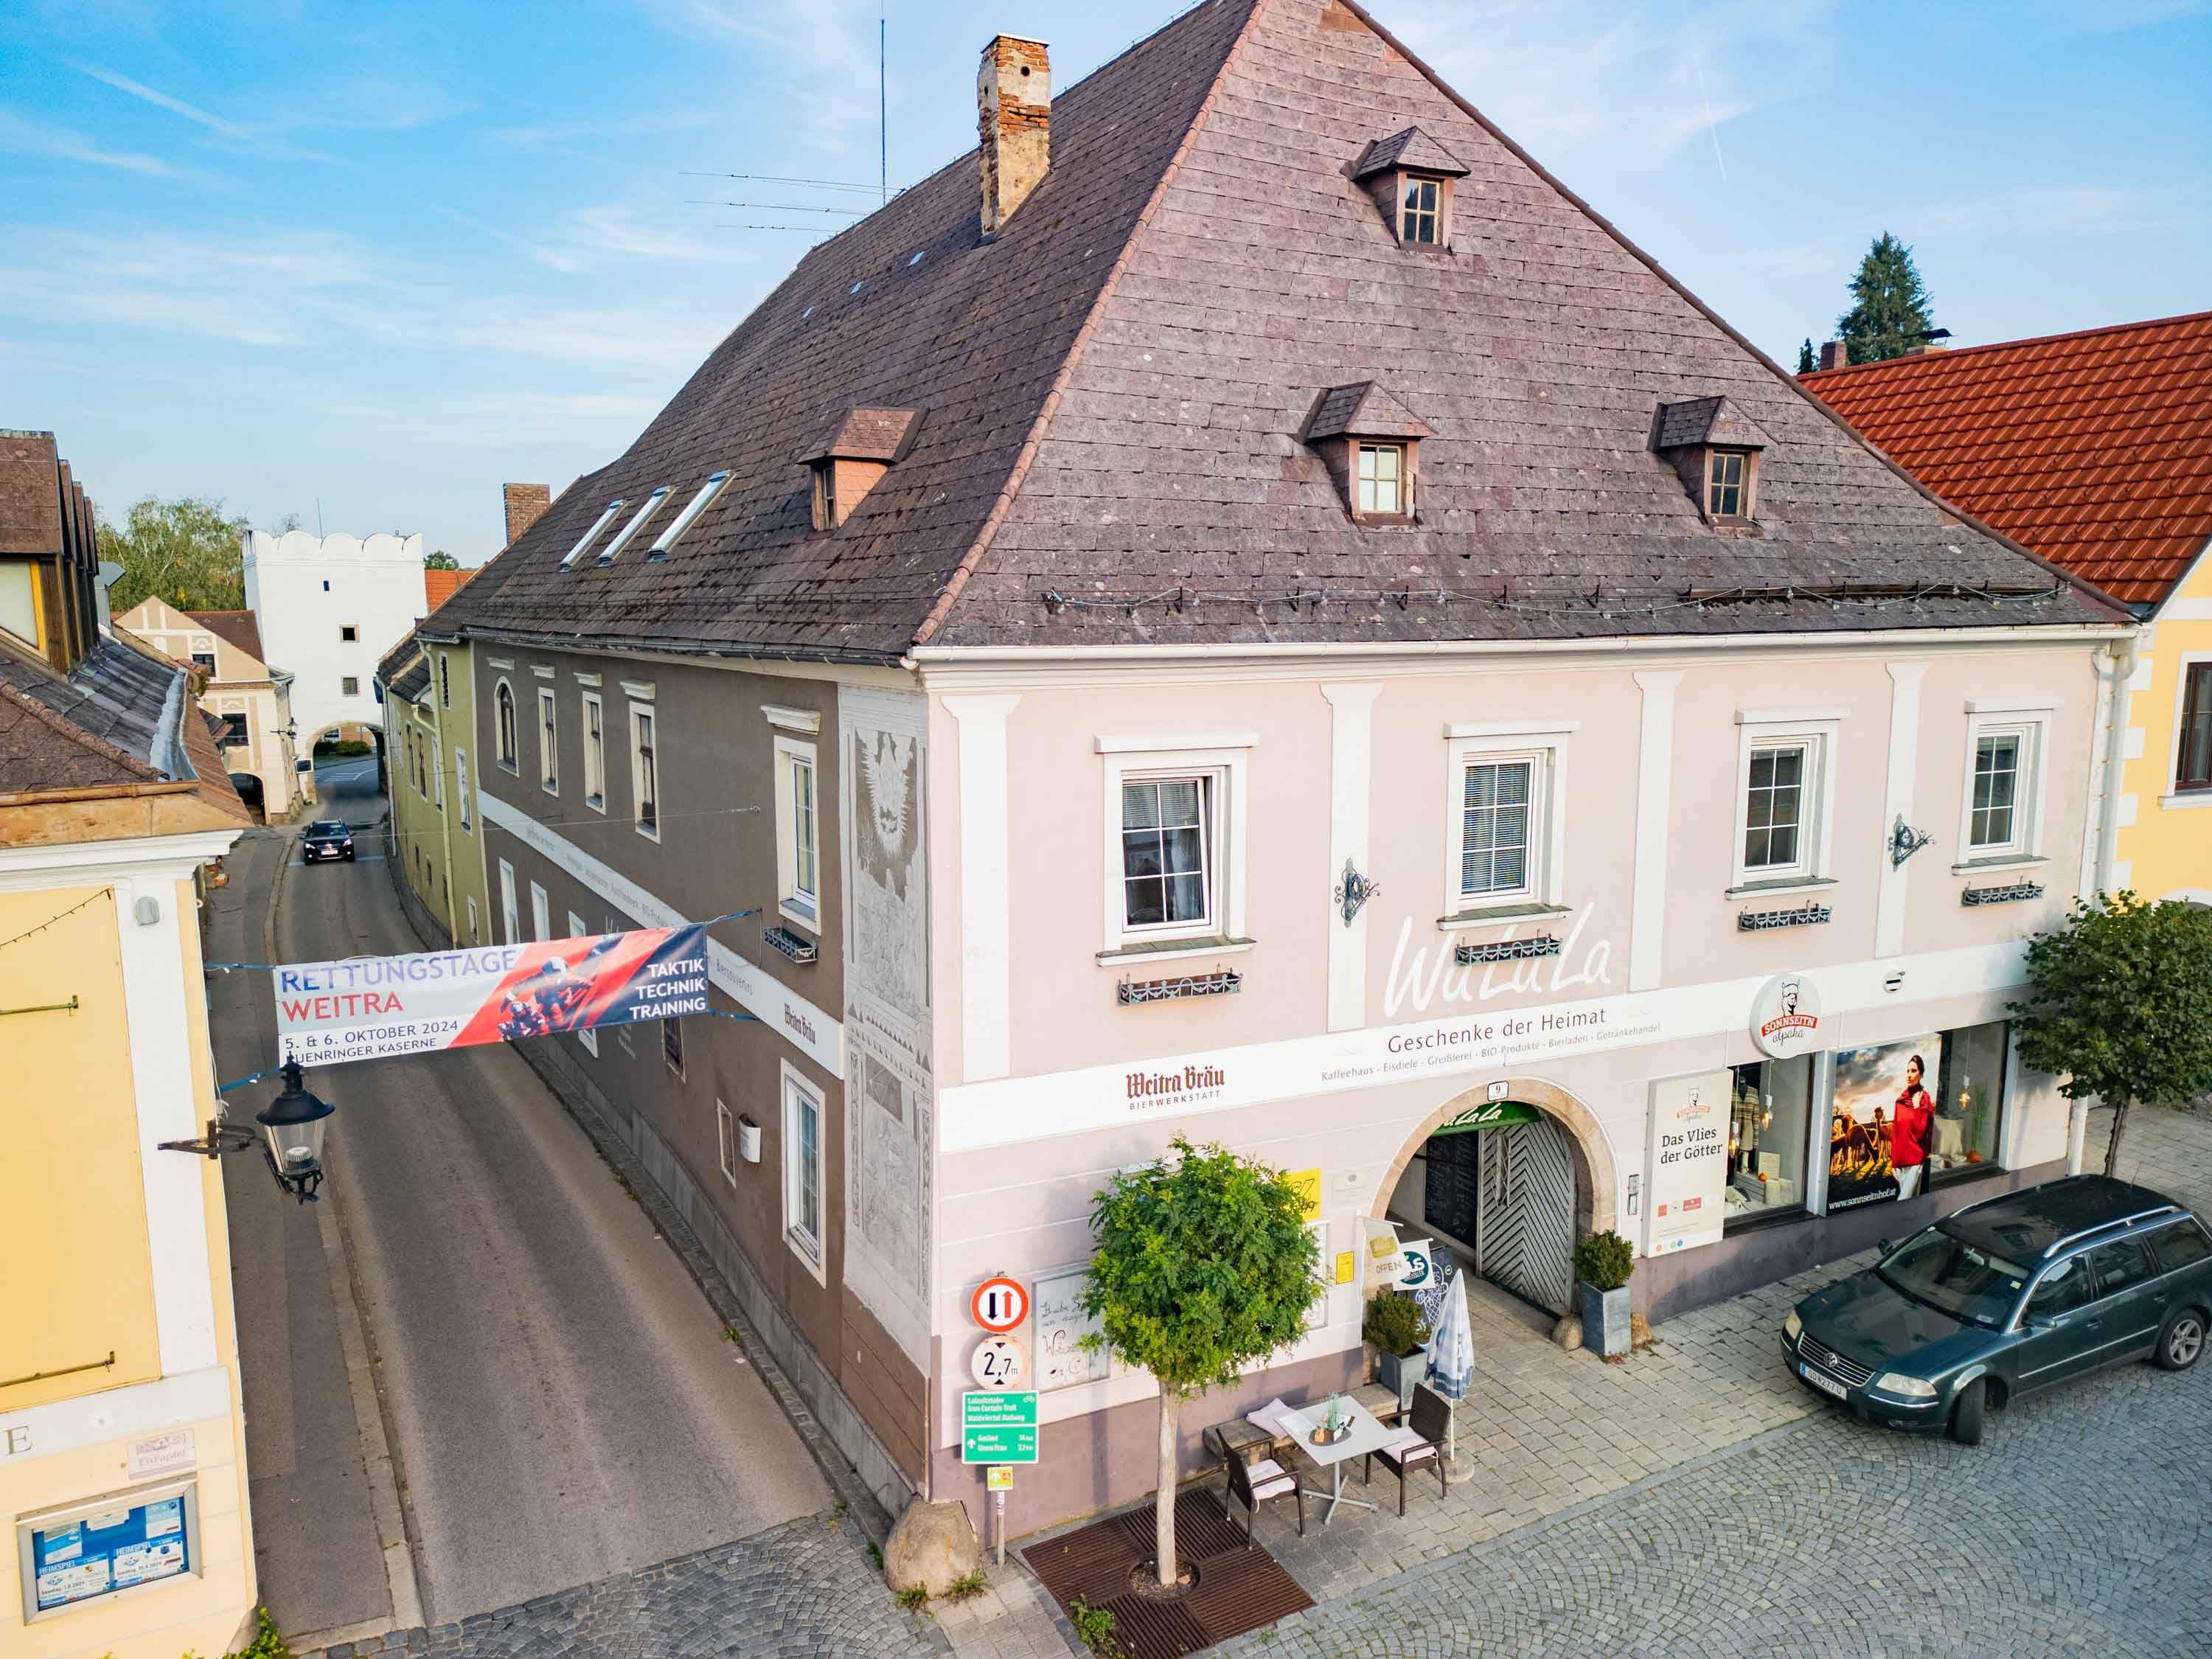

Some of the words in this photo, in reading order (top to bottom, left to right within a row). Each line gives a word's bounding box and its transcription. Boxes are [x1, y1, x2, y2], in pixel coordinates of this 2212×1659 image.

[281, 950, 517, 992] RETTUNGSTAGE
[647, 958, 705, 978] TAKTIK
[635, 977, 706, 1000] TECHNIK
[282, 991, 404, 1023] WEITRA
[629, 997, 706, 1020] TRAINING
[285, 1037, 300, 1050] 5.
[307, 1036, 318, 1047] &
[324, 1034, 338, 1046] 6.
[345, 1025, 417, 1043] OKTOBER
[422, 1020, 459, 1033] 2024
[1388, 1023, 1493, 1053] Geschenke
[1503, 1018, 1533, 1037] der
[1542, 1008, 1607, 1032] Heimat
[1763, 1016, 1815, 1034] SONNSEITN
[378, 1037, 437, 1054] KASERNE
[1772, 1027, 1805, 1046] alpaka
[1321, 1065, 1374, 1082] Kaffeehaus
[1382, 1059, 1418, 1073] Eisdiele
[1427, 1051, 1472, 1066] Greißlerei
[1481, 1040, 1540, 1058] BIO-Produkte
[1548, 1033, 1588, 1048] Bierladen
[1126, 1071, 1182, 1099] Weitra
[1184, 1065, 1225, 1090] Bräu
[1129, 1090, 1221, 1110] BIERWERKSTATT
[1662, 1135, 1684, 1147] Das
[1687, 1127, 1717, 1142] Vlies
[1660, 1150, 1681, 1164] der
[1684, 1144, 1723, 1160] Götter
[1829, 1187, 1896, 1210] www.sonnseitnhof.at
[116, 1540, 152, 1556] HEIMSPIEL
[40, 1559, 77, 1576] HEIMSPIEL
